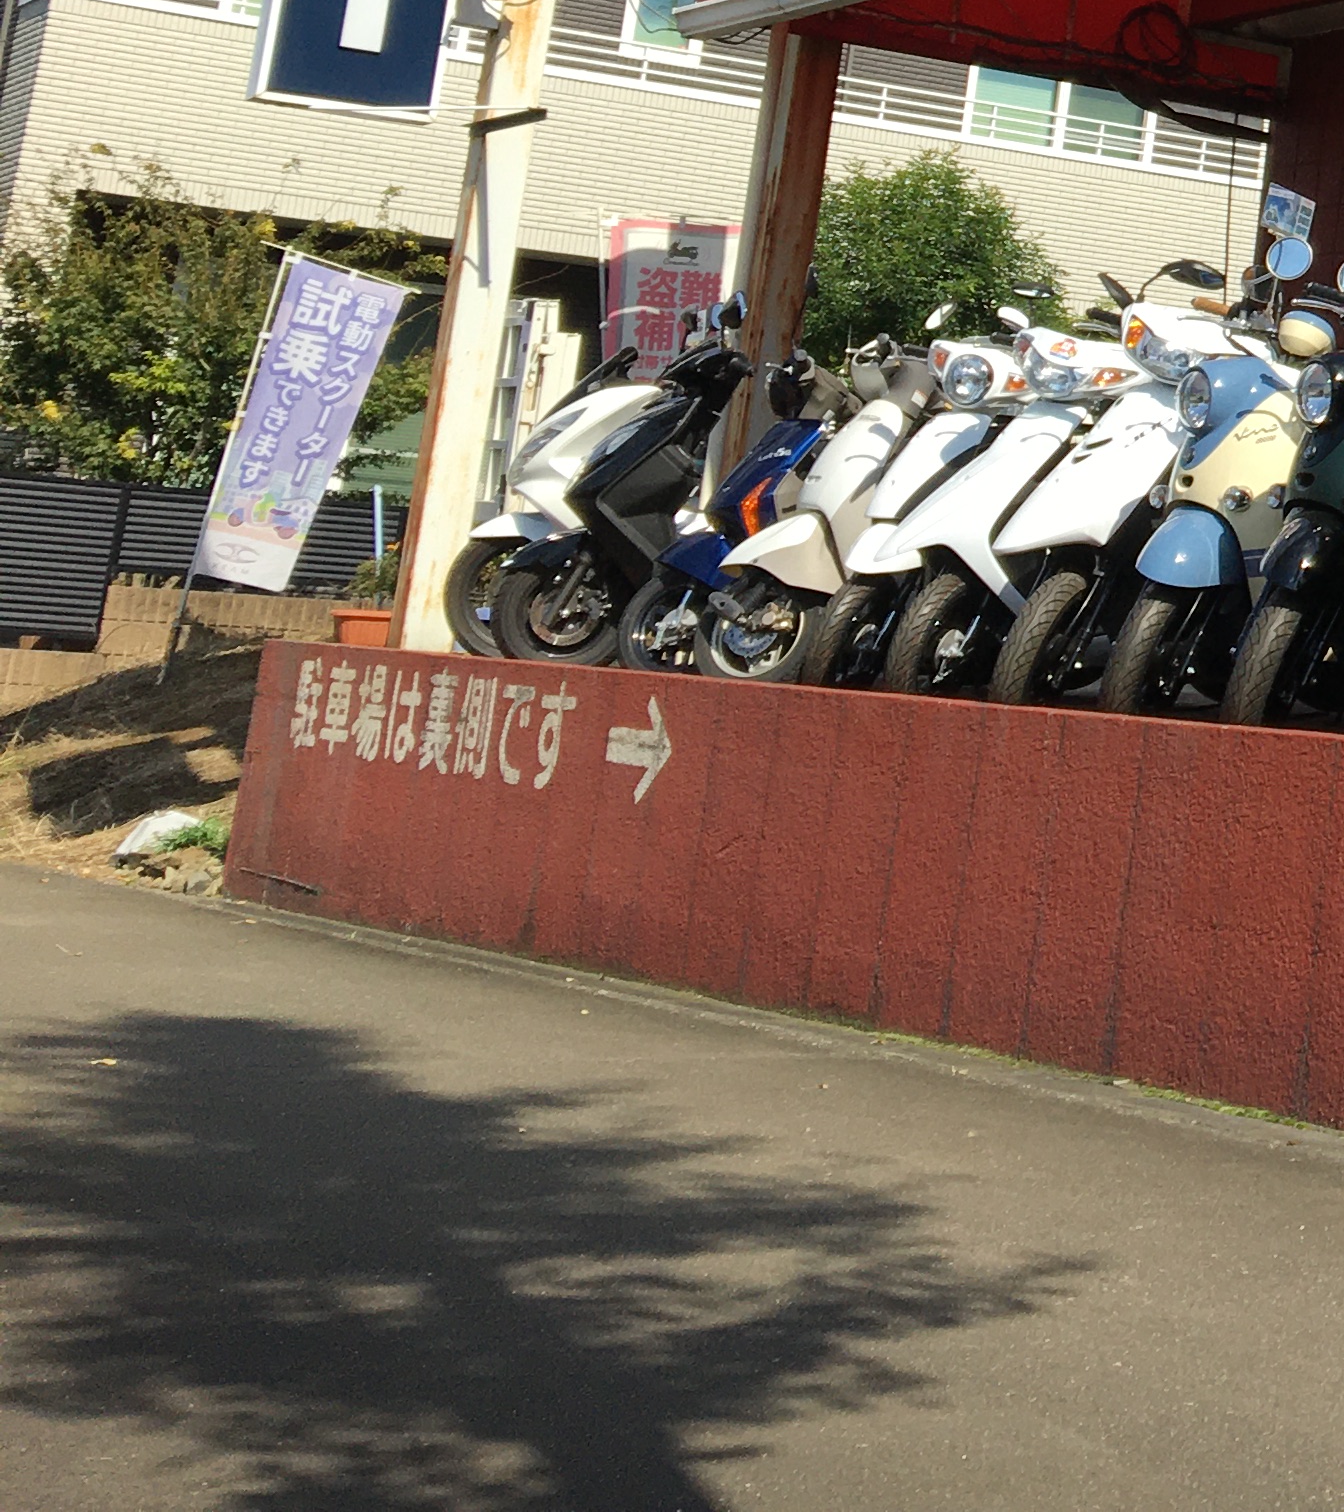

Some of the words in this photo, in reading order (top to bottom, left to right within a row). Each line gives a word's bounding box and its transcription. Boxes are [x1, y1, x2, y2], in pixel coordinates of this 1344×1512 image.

[240, 278, 354, 489] 試乗できます
[293, 292, 386, 487] 電動スクーター
[289, 658, 577, 789] 駐車場は裏側です
